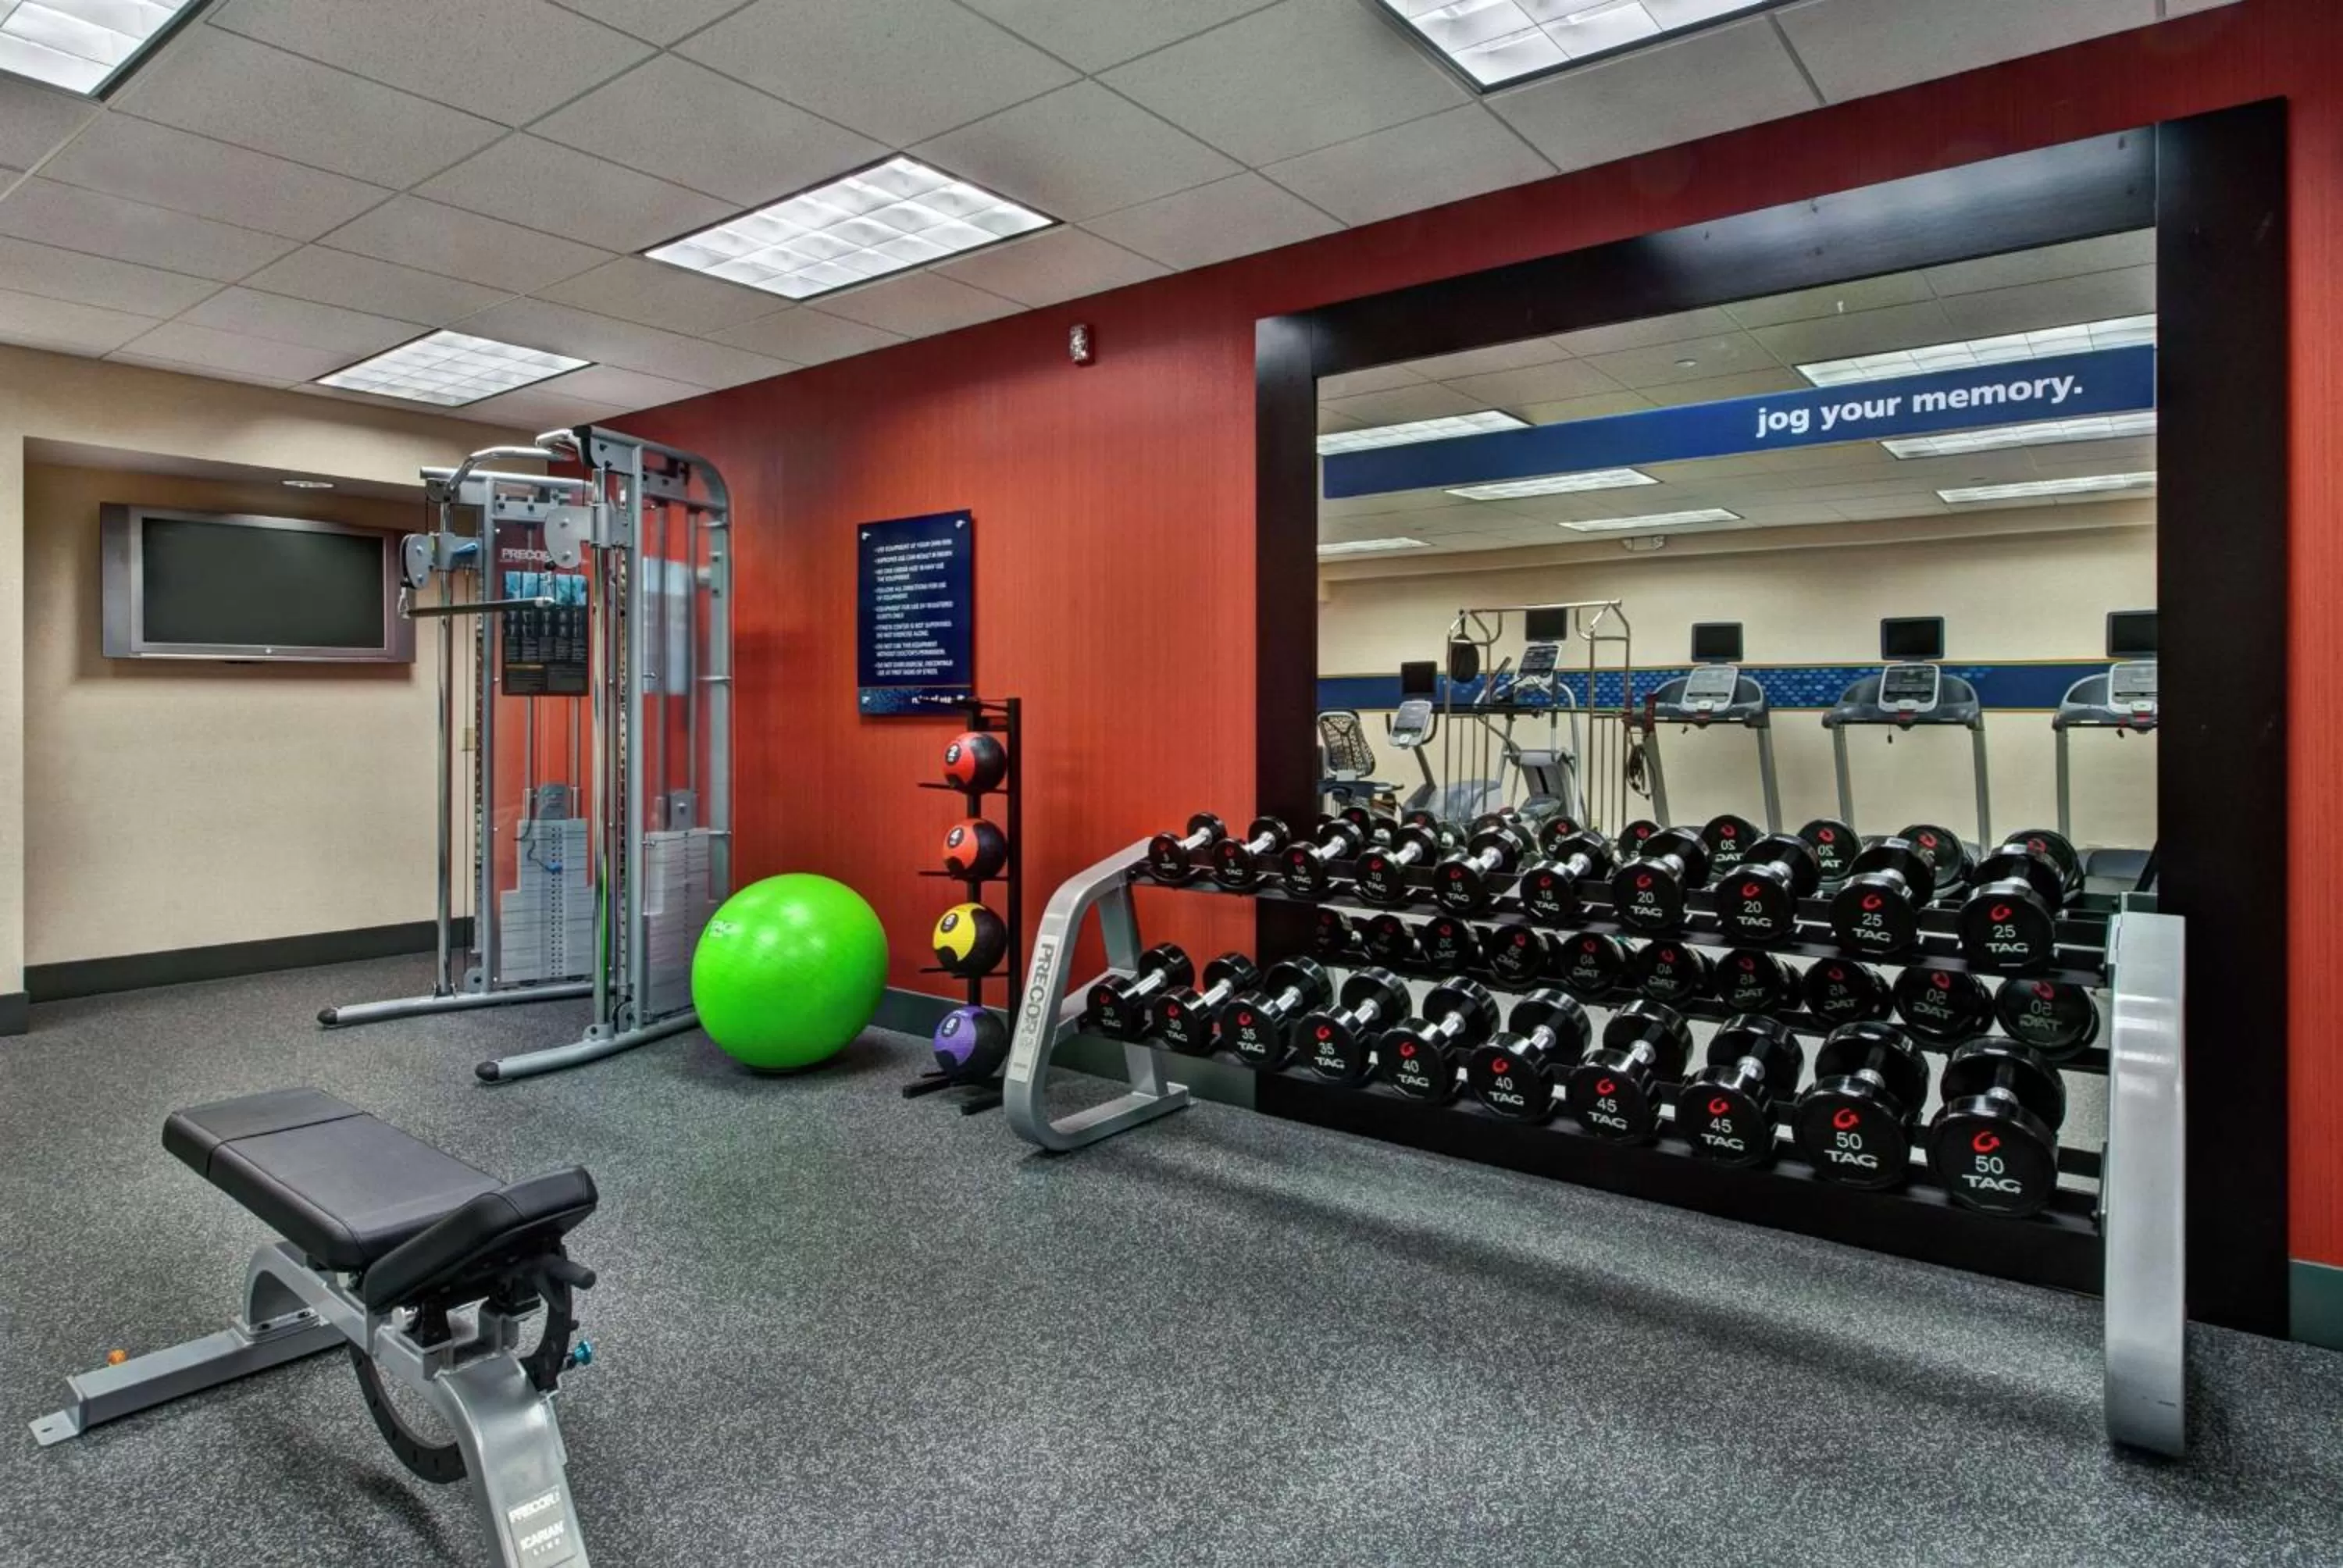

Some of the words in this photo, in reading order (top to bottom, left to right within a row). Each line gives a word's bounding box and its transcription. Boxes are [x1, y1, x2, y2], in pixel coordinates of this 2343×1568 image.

[1756, 408, 1810, 438] jog
[1820, 397, 1902, 431] your
[1912, 375, 2082, 415] memory.
[1291, 875, 1312, 884] TAG
[1365, 880, 1387, 893] TAG
[1446, 892, 1470, 902] TAG
[1637, 891, 1655, 903] 20
[1534, 900, 1560, 911] TAG
[1630, 905, 1663, 918] TAG
[1743, 900, 1762, 914] 20
[1736, 916, 1773, 928] TAG
[1861, 912, 1883, 927] 25
[1852, 928, 1892, 943] TAG
[1992, 924, 2017, 939] 25
[1985, 943, 2029, 954] TAG
[1021, 943, 1055, 1035] PRECOR
[1166, 1029, 1189, 1042] TAG
[1240, 1027, 1257, 1040] 35
[1236, 1041, 1266, 1055] TAG
[1318, 1042, 1336, 1055] 35
[1314, 1056, 1346, 1070] TAG
[1402, 1060, 1420, 1073] 40
[1396, 1073, 1430, 1088] TAG
[1495, 1076, 1514, 1090] 40
[1489, 1091, 1525, 1107] TAG
[1596, 1096, 1618, 1114] 45
[1587, 1110, 1628, 1131] TAG
[1710, 1117, 1733, 1134] 45
[1700, 1132, 1745, 1152] TAG
[1835, 1131, 1863, 1150] 50
[1824, 1149, 1879, 1169] TAG
[1975, 1155, 2005, 1175] 50
[1961, 1174, 2023, 1195] TAG
